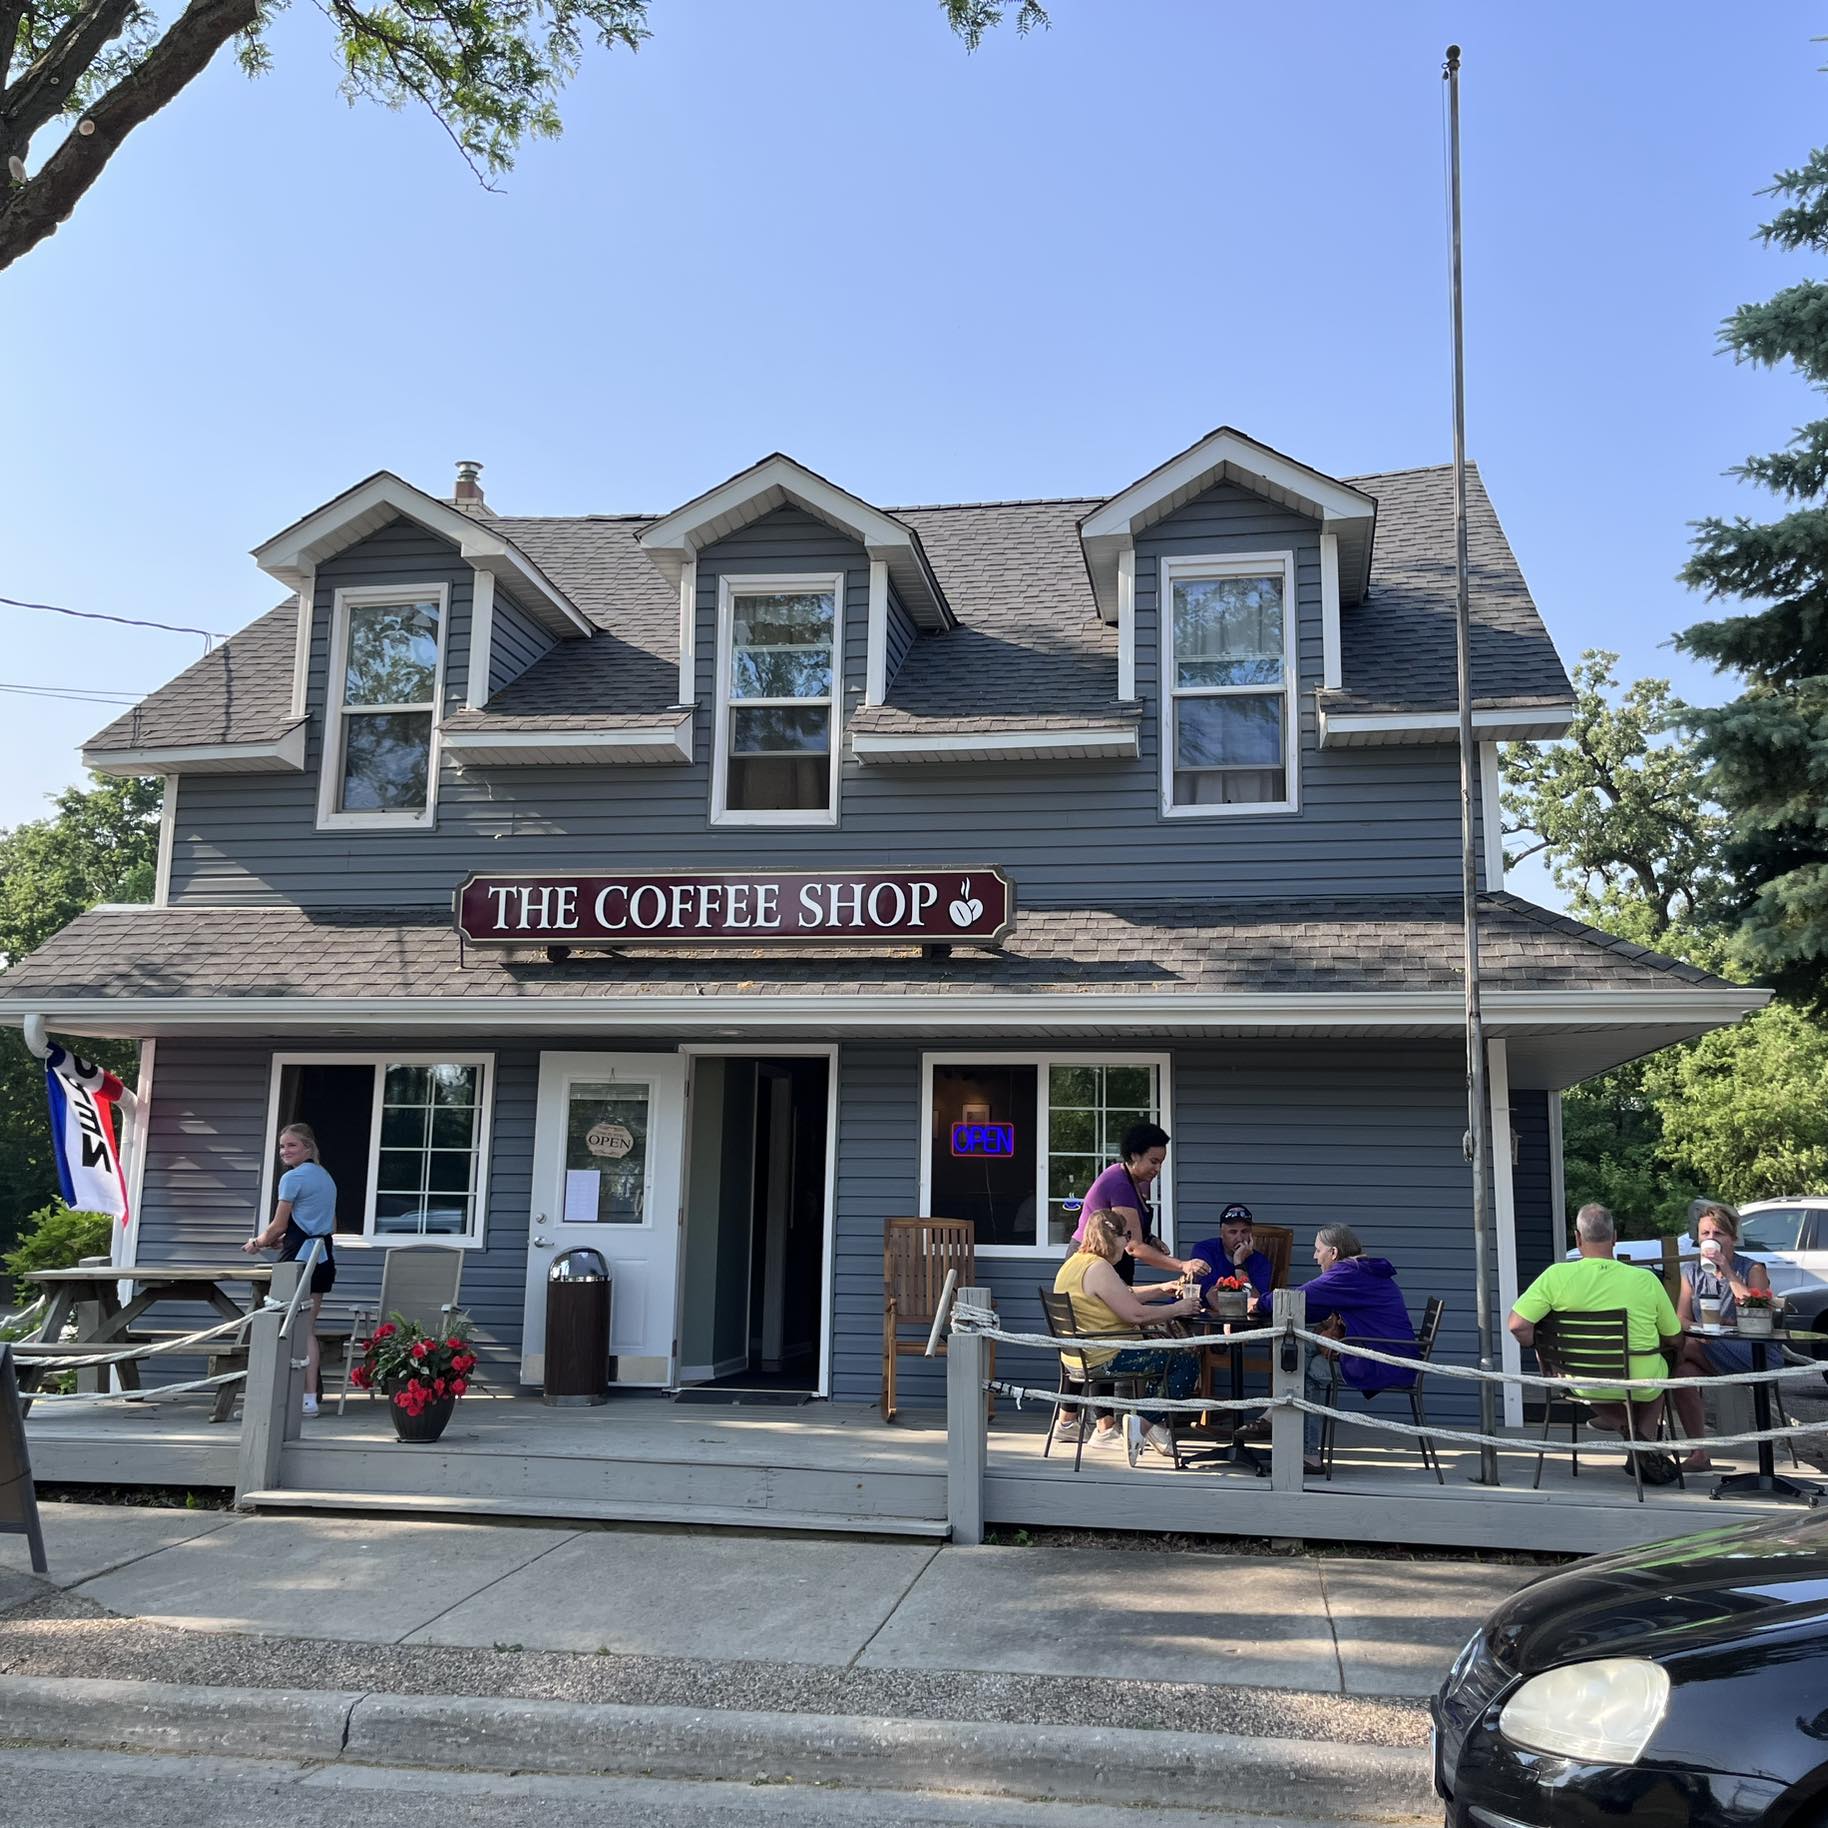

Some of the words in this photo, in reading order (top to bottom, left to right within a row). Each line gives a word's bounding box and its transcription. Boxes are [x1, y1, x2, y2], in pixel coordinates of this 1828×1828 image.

[488, 885, 579, 930] THE
[594, 883, 780, 929] COFFEE
[798, 882, 937, 928] SHOP
[588, 1135, 631, 1149] OPEN
[954, 1126, 1012, 1153] OPEN
